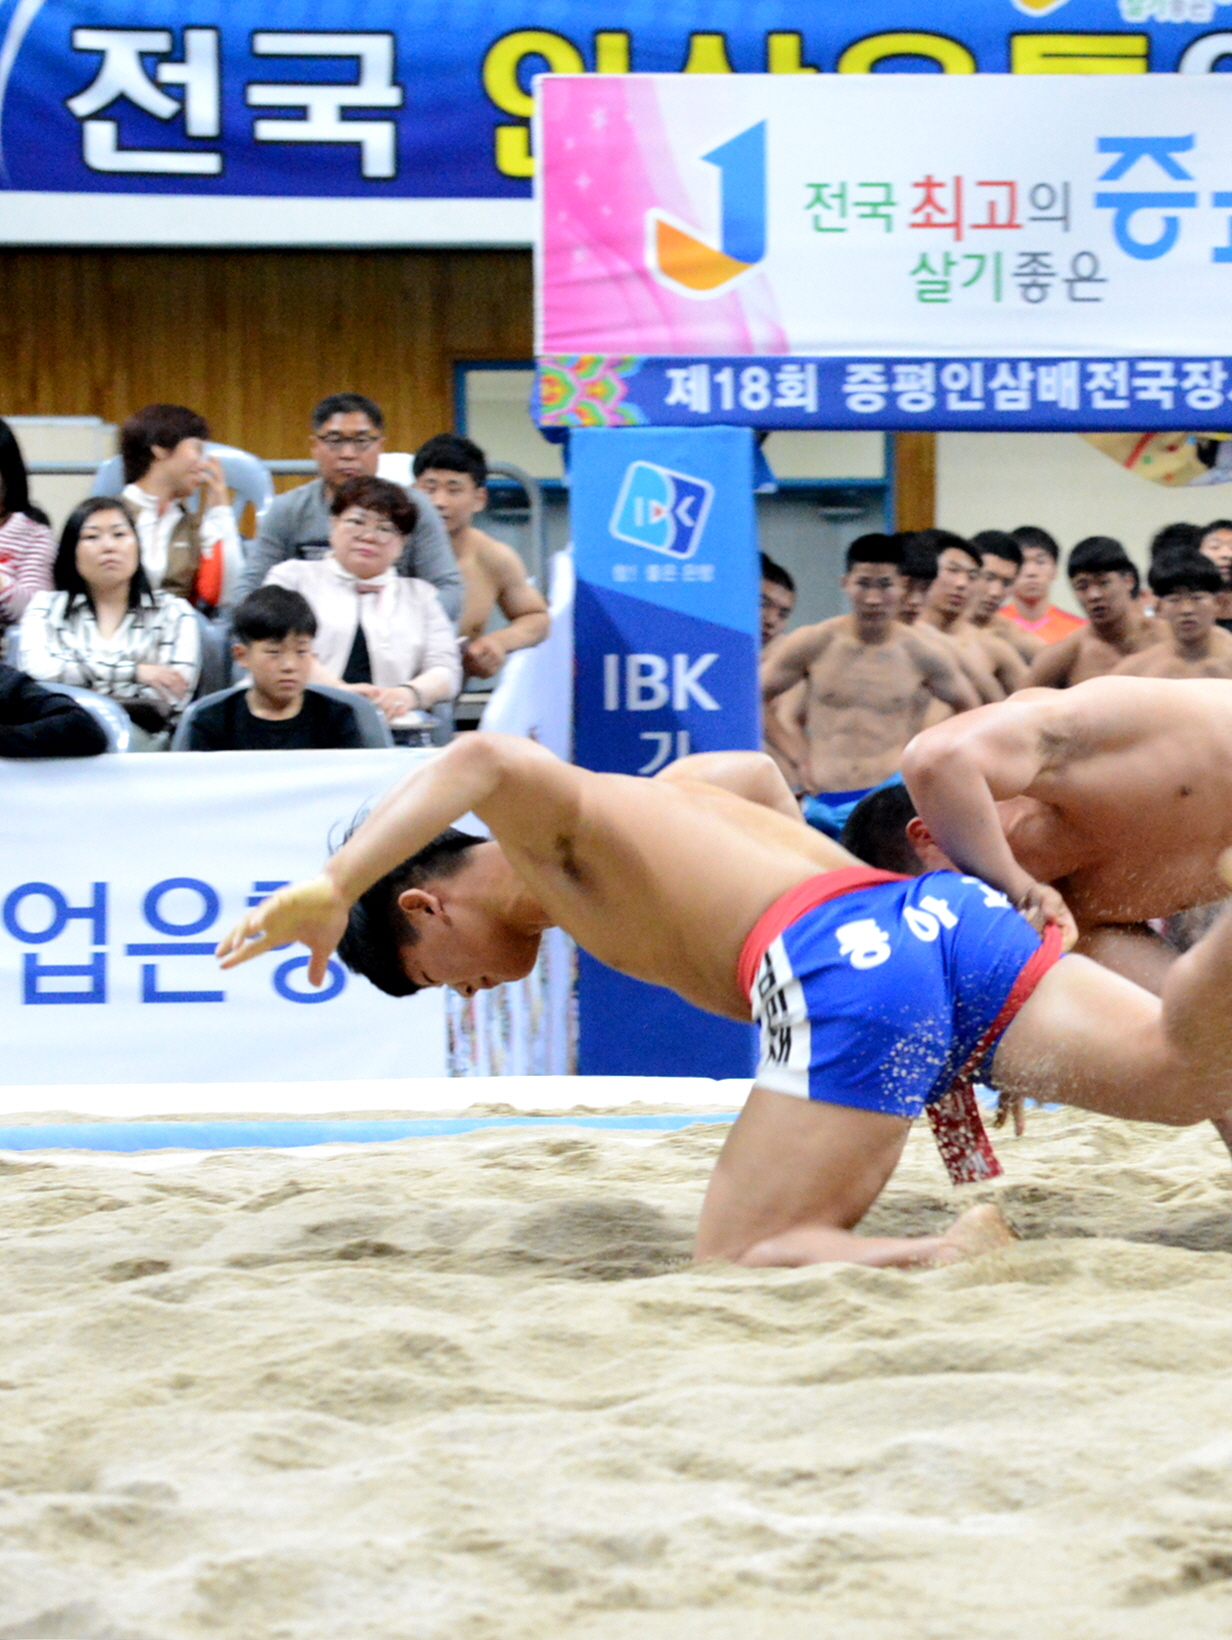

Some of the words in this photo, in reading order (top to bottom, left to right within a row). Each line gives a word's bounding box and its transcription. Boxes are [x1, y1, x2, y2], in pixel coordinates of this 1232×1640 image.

[67, 27, 400, 178] 전국
[804, 181, 897, 233] 전국
[908, 174, 1071, 242] 최고의
[665, 363, 819, 413] 제18회
[604, 653, 722, 712] IBK
